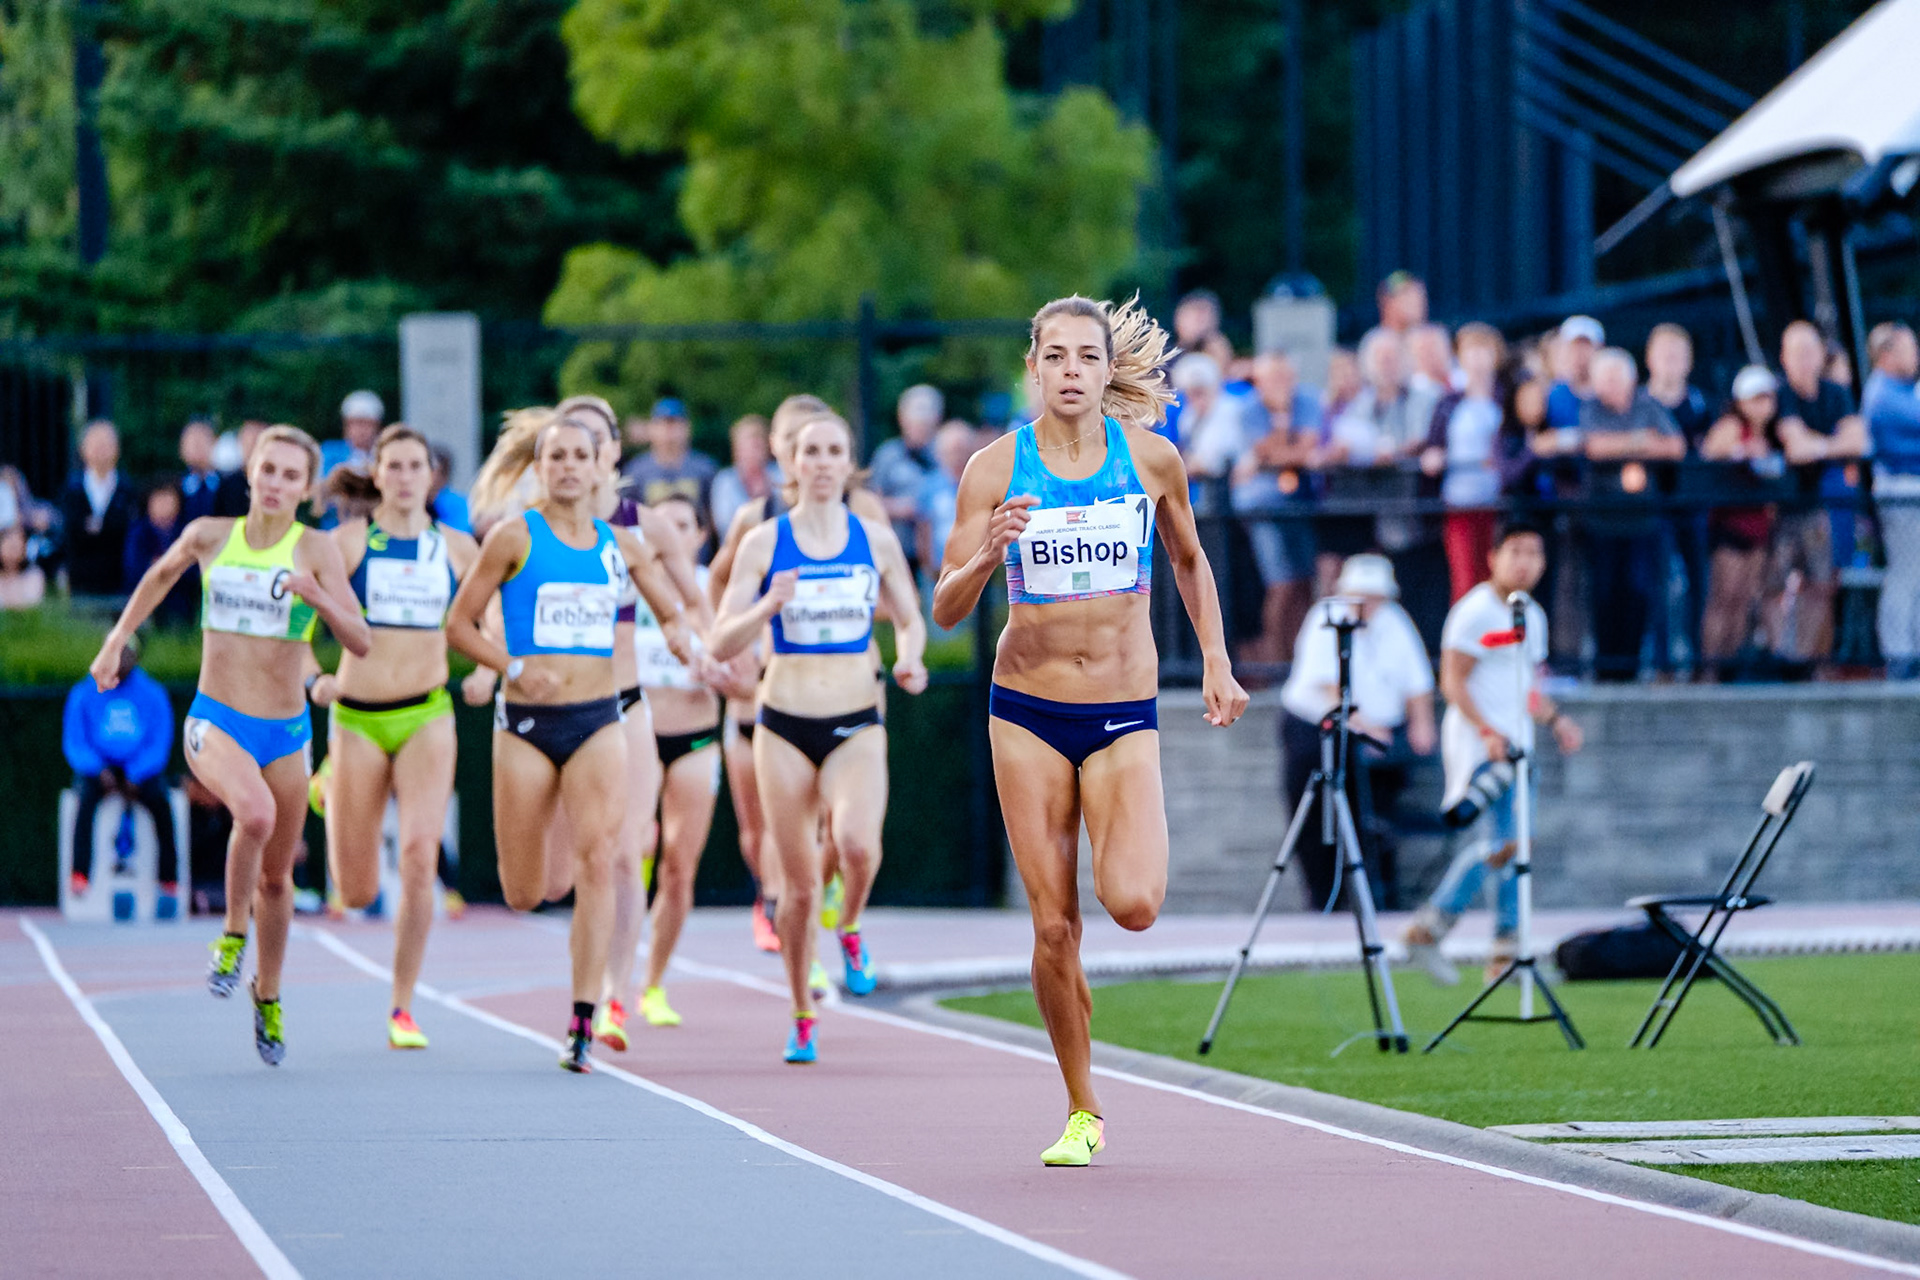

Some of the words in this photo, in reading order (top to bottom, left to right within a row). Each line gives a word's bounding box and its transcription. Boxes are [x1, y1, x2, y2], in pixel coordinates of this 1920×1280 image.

[1098, 523, 1121, 531] CLASSIC
[1135, 497, 1148, 545] 1
[427, 531, 439, 561] 7
[1031, 537, 1128, 567] Bishop
[271, 569, 292, 600] 6
[861, 569, 873, 601] 2
